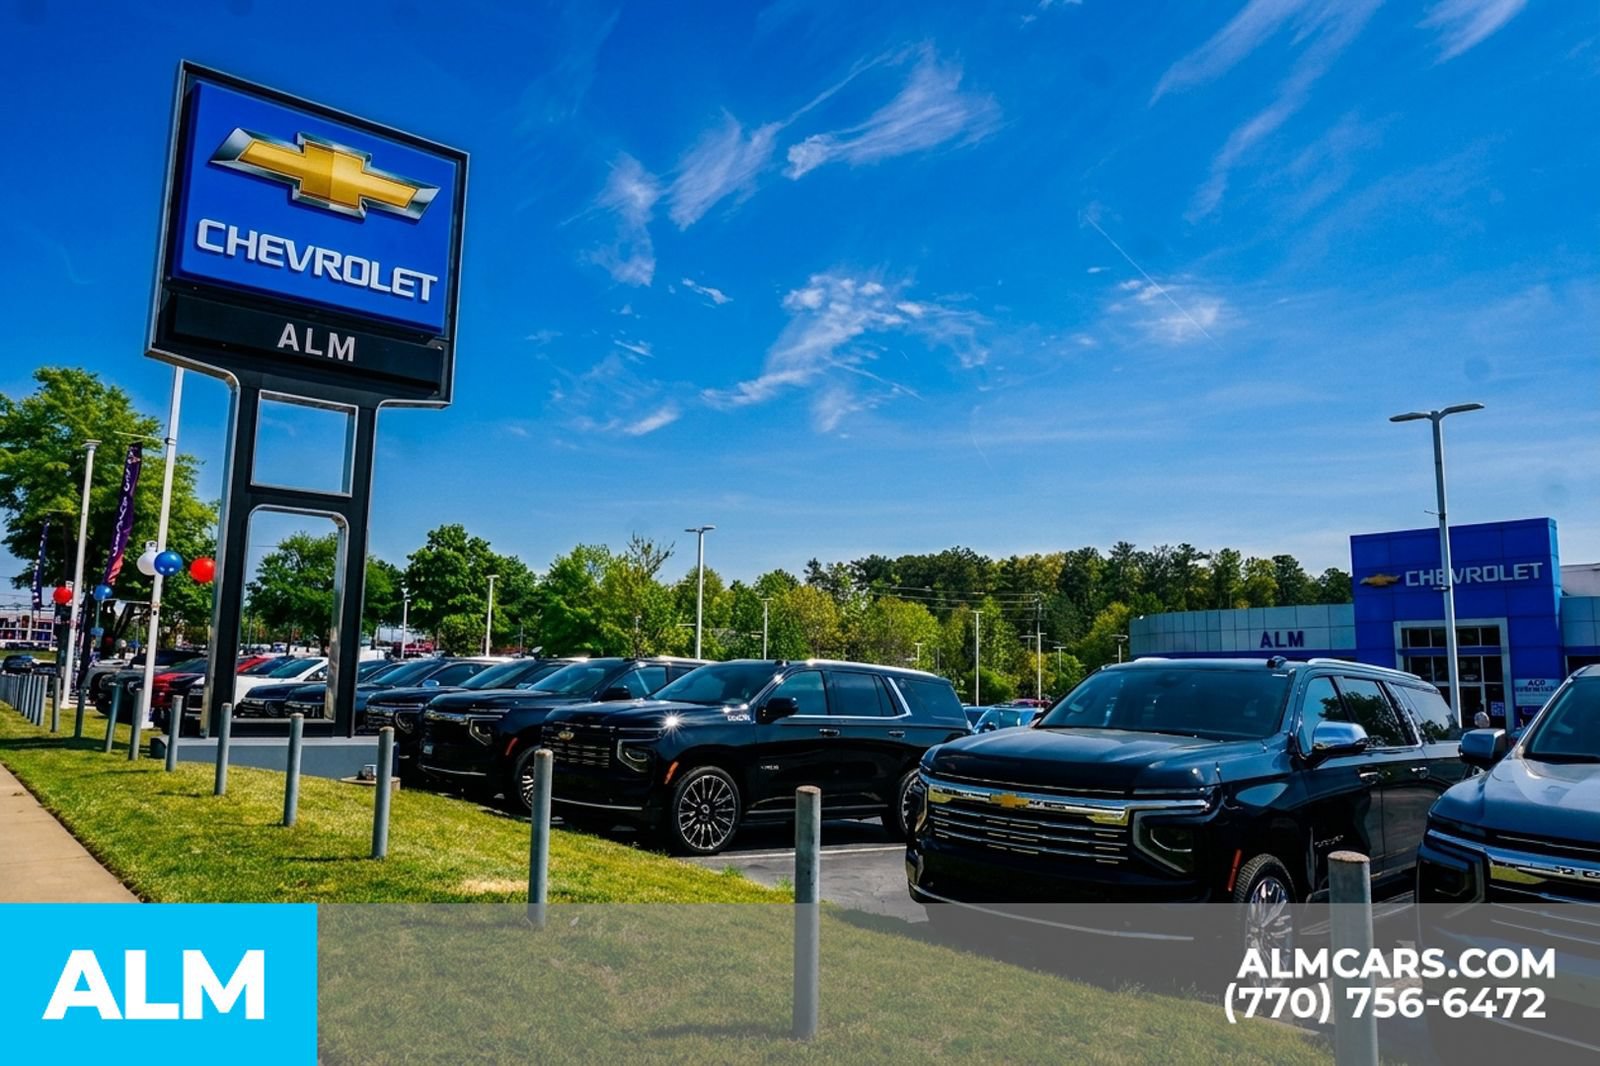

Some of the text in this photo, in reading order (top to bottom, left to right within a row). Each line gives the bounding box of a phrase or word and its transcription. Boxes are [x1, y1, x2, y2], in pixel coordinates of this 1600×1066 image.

[196, 217, 438, 302] CHEVROLET
[277, 322, 356, 362] ALM
[1405, 562, 1543, 587] CHEVROLET
[1260, 630, 1304, 648] ALM
